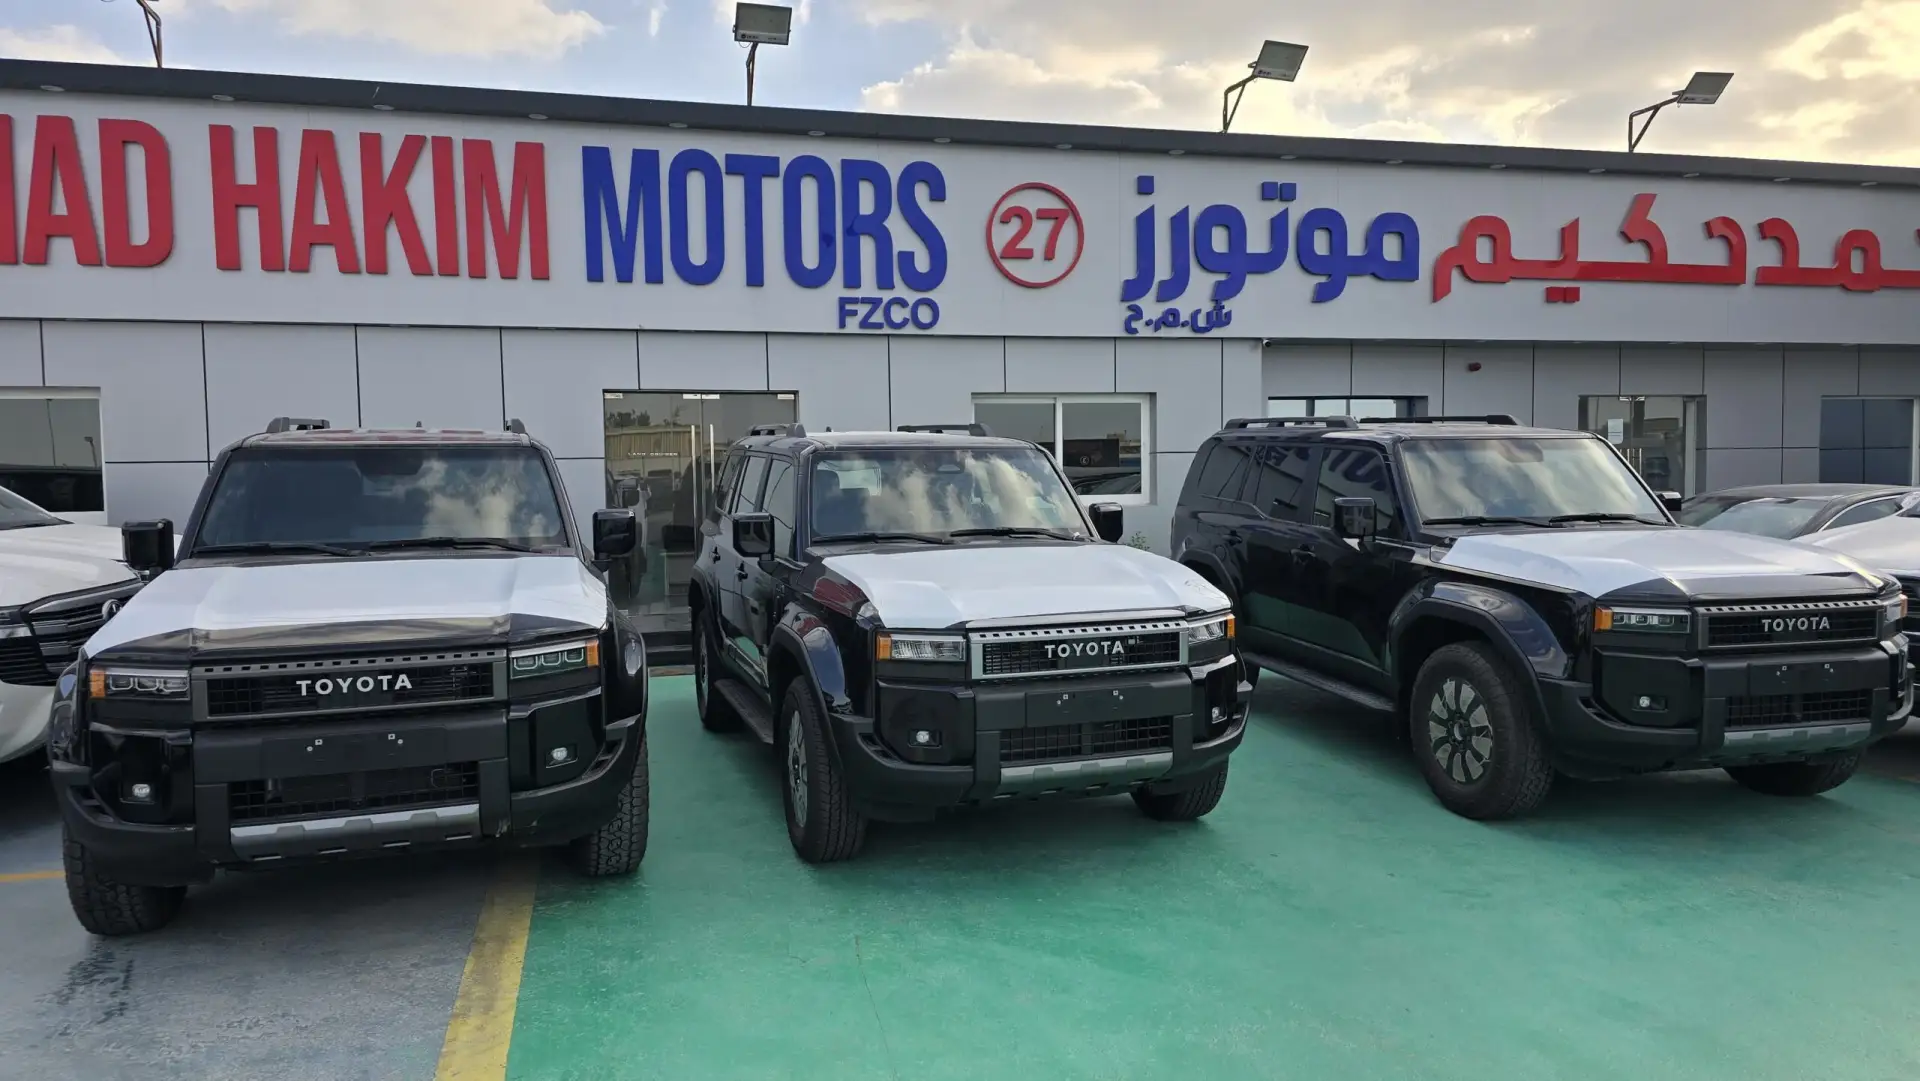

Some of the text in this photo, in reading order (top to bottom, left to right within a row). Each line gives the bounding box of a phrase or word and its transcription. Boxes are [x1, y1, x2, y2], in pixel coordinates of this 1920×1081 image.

[0, 114, 948, 292] AD HAKIM MOTORS
[1000, 206, 1070, 261] 27
[1121, 176, 1420, 303] موتورز
[1433, 193, 1747, 303] حكيم
[838, 296, 940, 330] FZCO
[1761, 616, 1831, 632] TOYOTA
[1044, 640, 1124, 659] TOYOTA
[295, 673, 413, 697] TOYOTA
